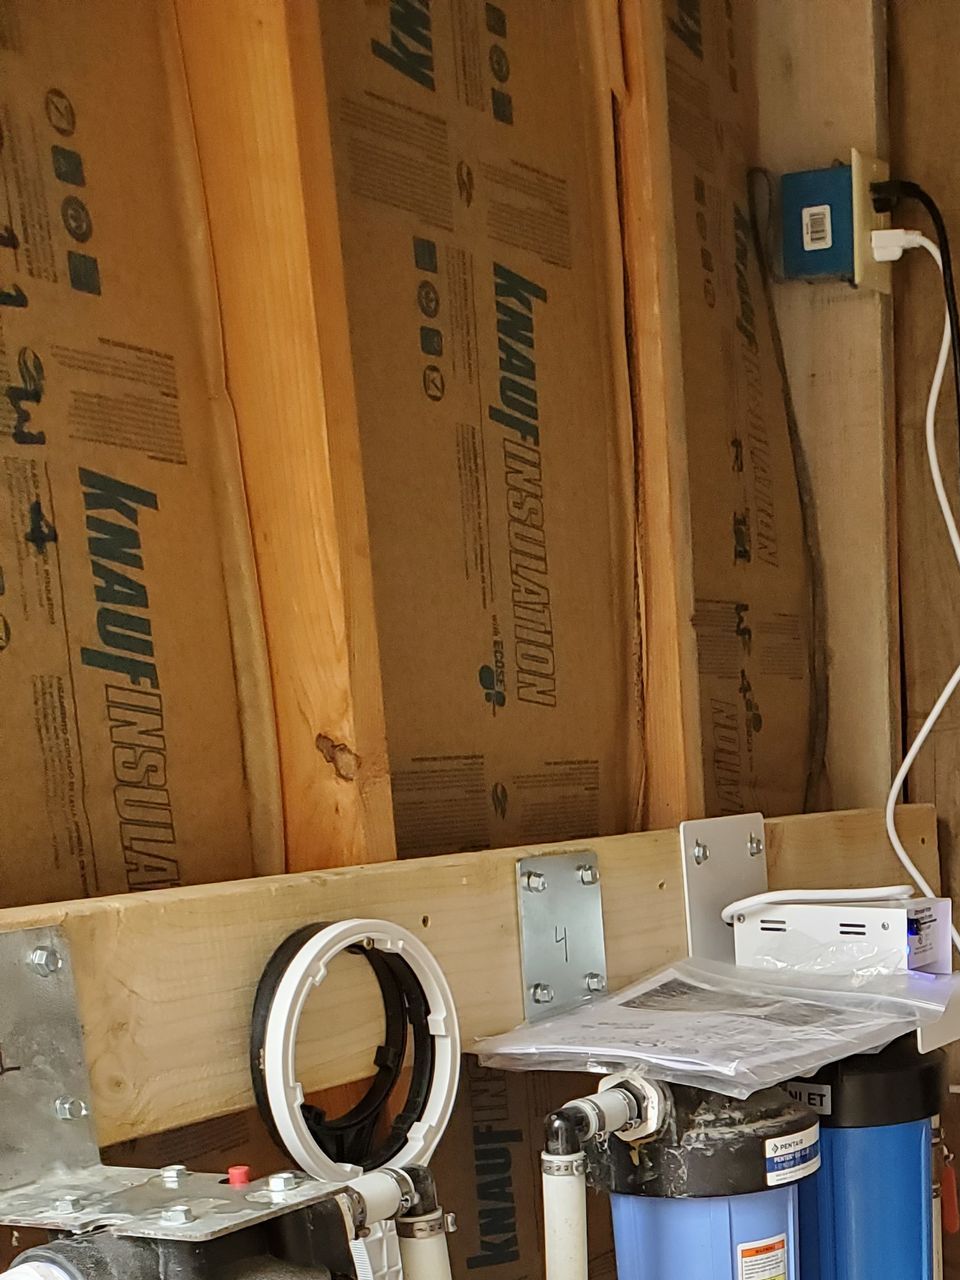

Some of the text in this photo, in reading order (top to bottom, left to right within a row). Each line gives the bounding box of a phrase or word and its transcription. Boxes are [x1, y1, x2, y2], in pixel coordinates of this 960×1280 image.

[489, 262, 548, 446] KNAUF
[78, 467, 160, 689] KNAUF
[503, 440, 558, 708] INSULATION
[554, 924, 570, 963] 4
[466, 1124, 524, 1270] KNAUF
